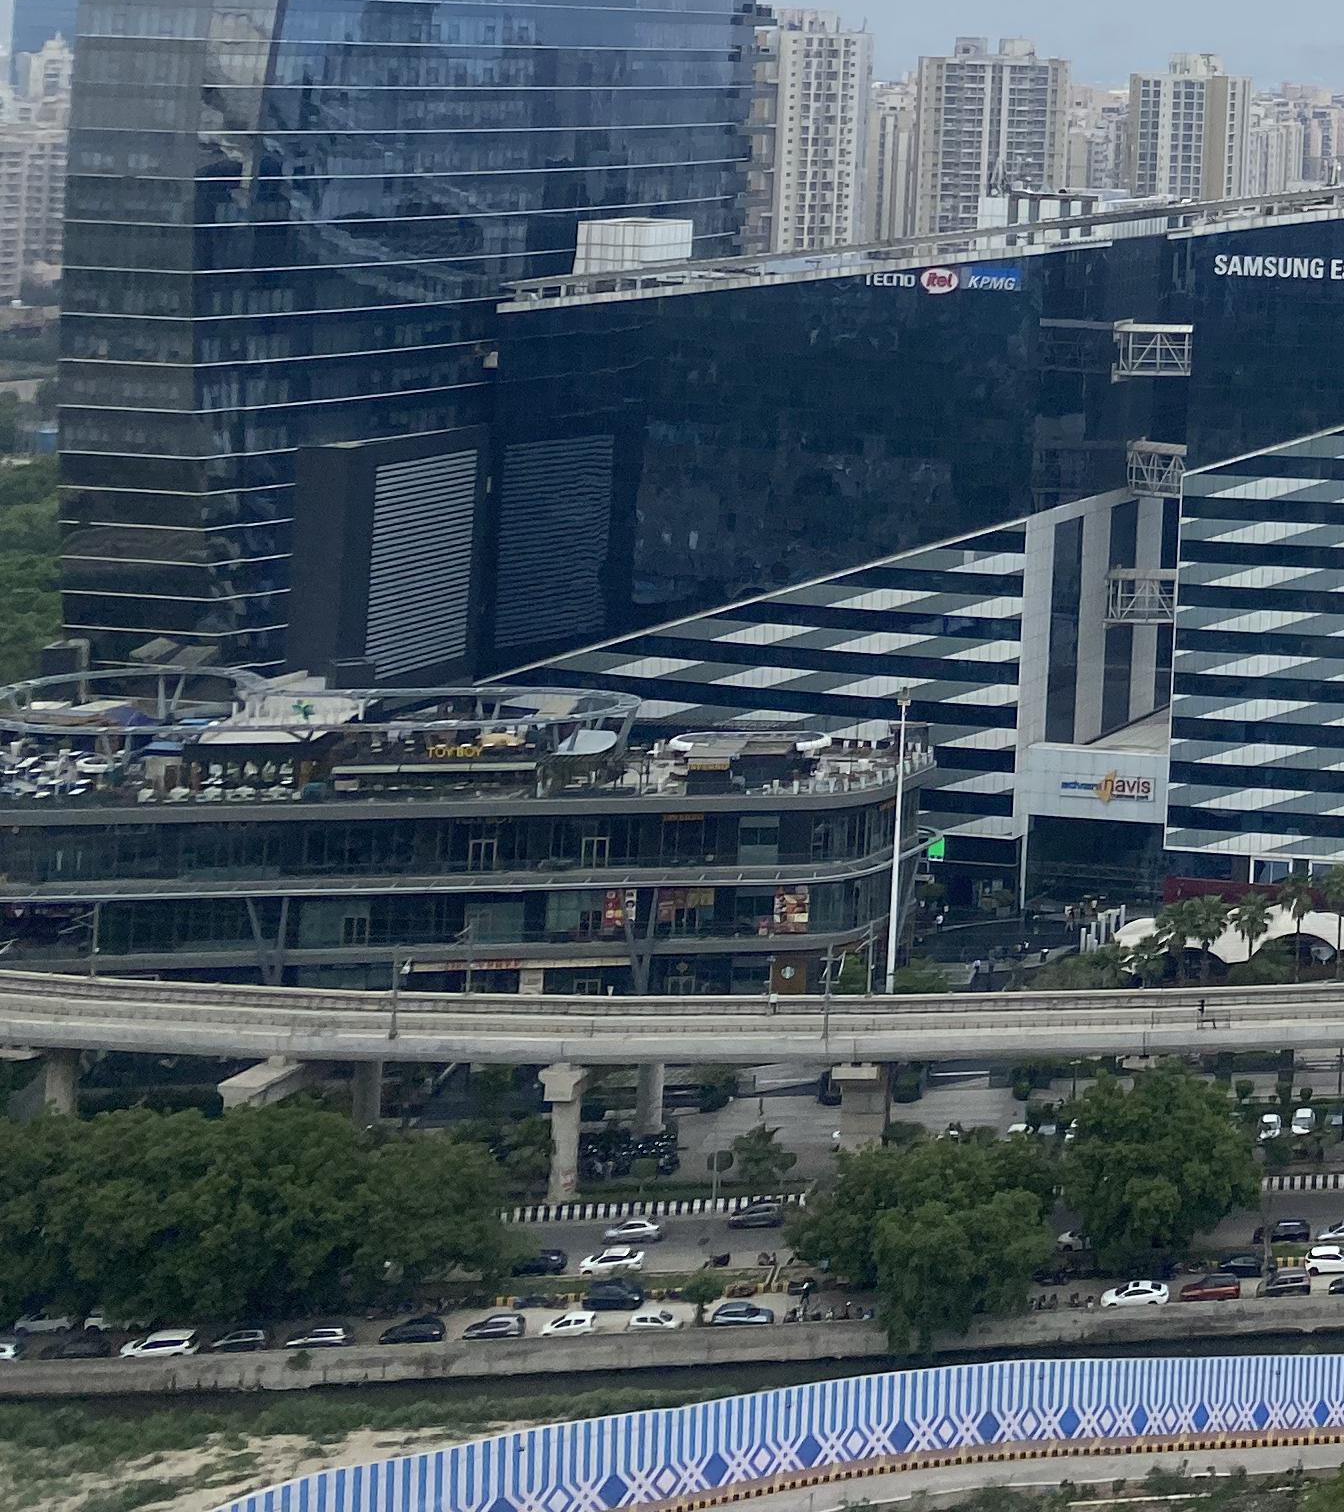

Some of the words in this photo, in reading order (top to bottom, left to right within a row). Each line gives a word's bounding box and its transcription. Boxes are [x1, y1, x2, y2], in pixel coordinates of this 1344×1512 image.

[1214, 254, 1324, 279] SAMSUNG
[866, 273, 916, 287] TECNO
[926, 272, 953, 288] itel
[967, 275, 1017, 290] KPMG
